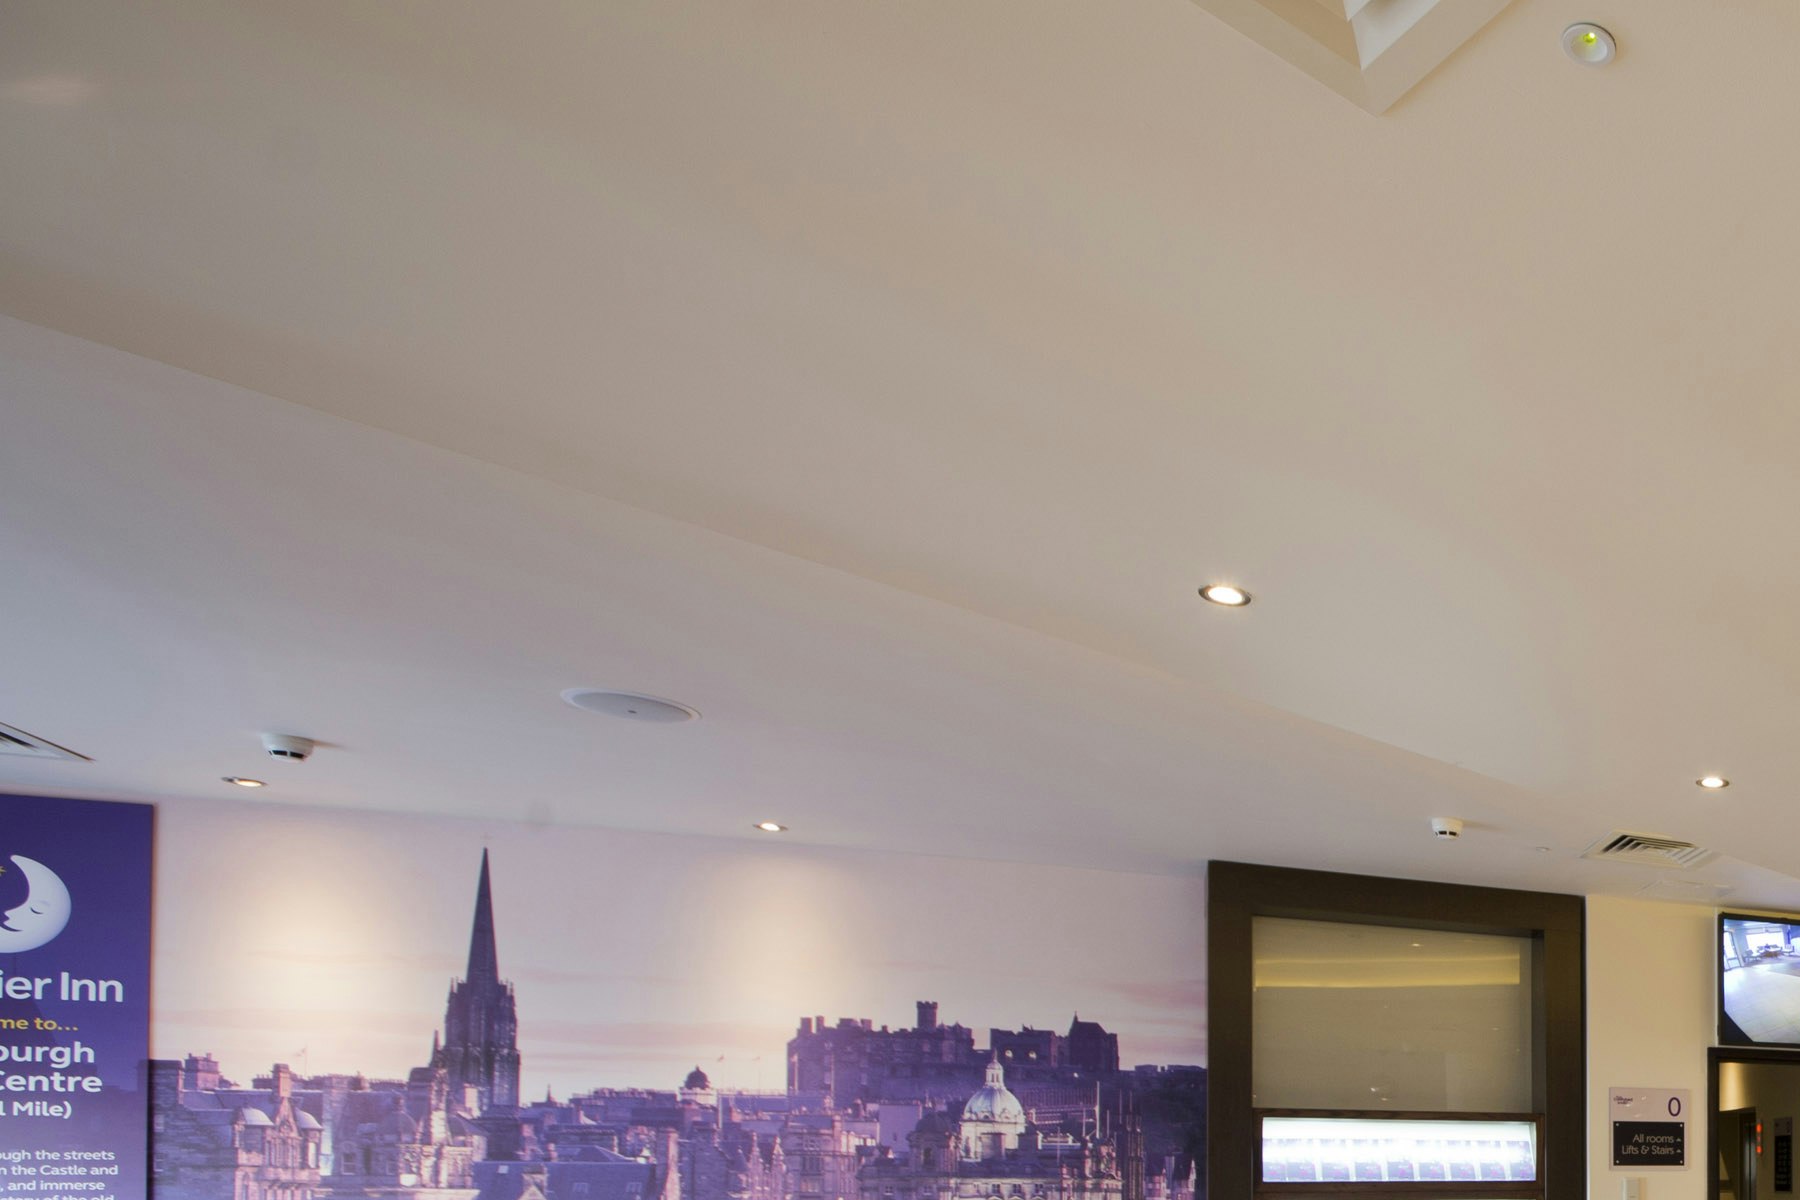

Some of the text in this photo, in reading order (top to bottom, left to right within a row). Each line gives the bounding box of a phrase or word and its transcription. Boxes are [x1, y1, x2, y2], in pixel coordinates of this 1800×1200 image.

[60, 971, 124, 1002] Inn
[34, 1017, 79, 1031] to...
[0, 1071, 103, 1093] entre
[12, 1100, 72, 1119] Mile)
[1632, 1133, 1674, 1143] All rooms
[0, 1150, 116, 1162] ugh the streets
[1621, 1145, 1674, 1155] Lifts & Stairs
[11, 1165, 37, 1176] the
[40, 1164, 87, 1176] Castle
[90, 1165, 119, 1176] and
[7, 1180, 36, 1191] and
[40, 1180, 106, 1191] immerse
